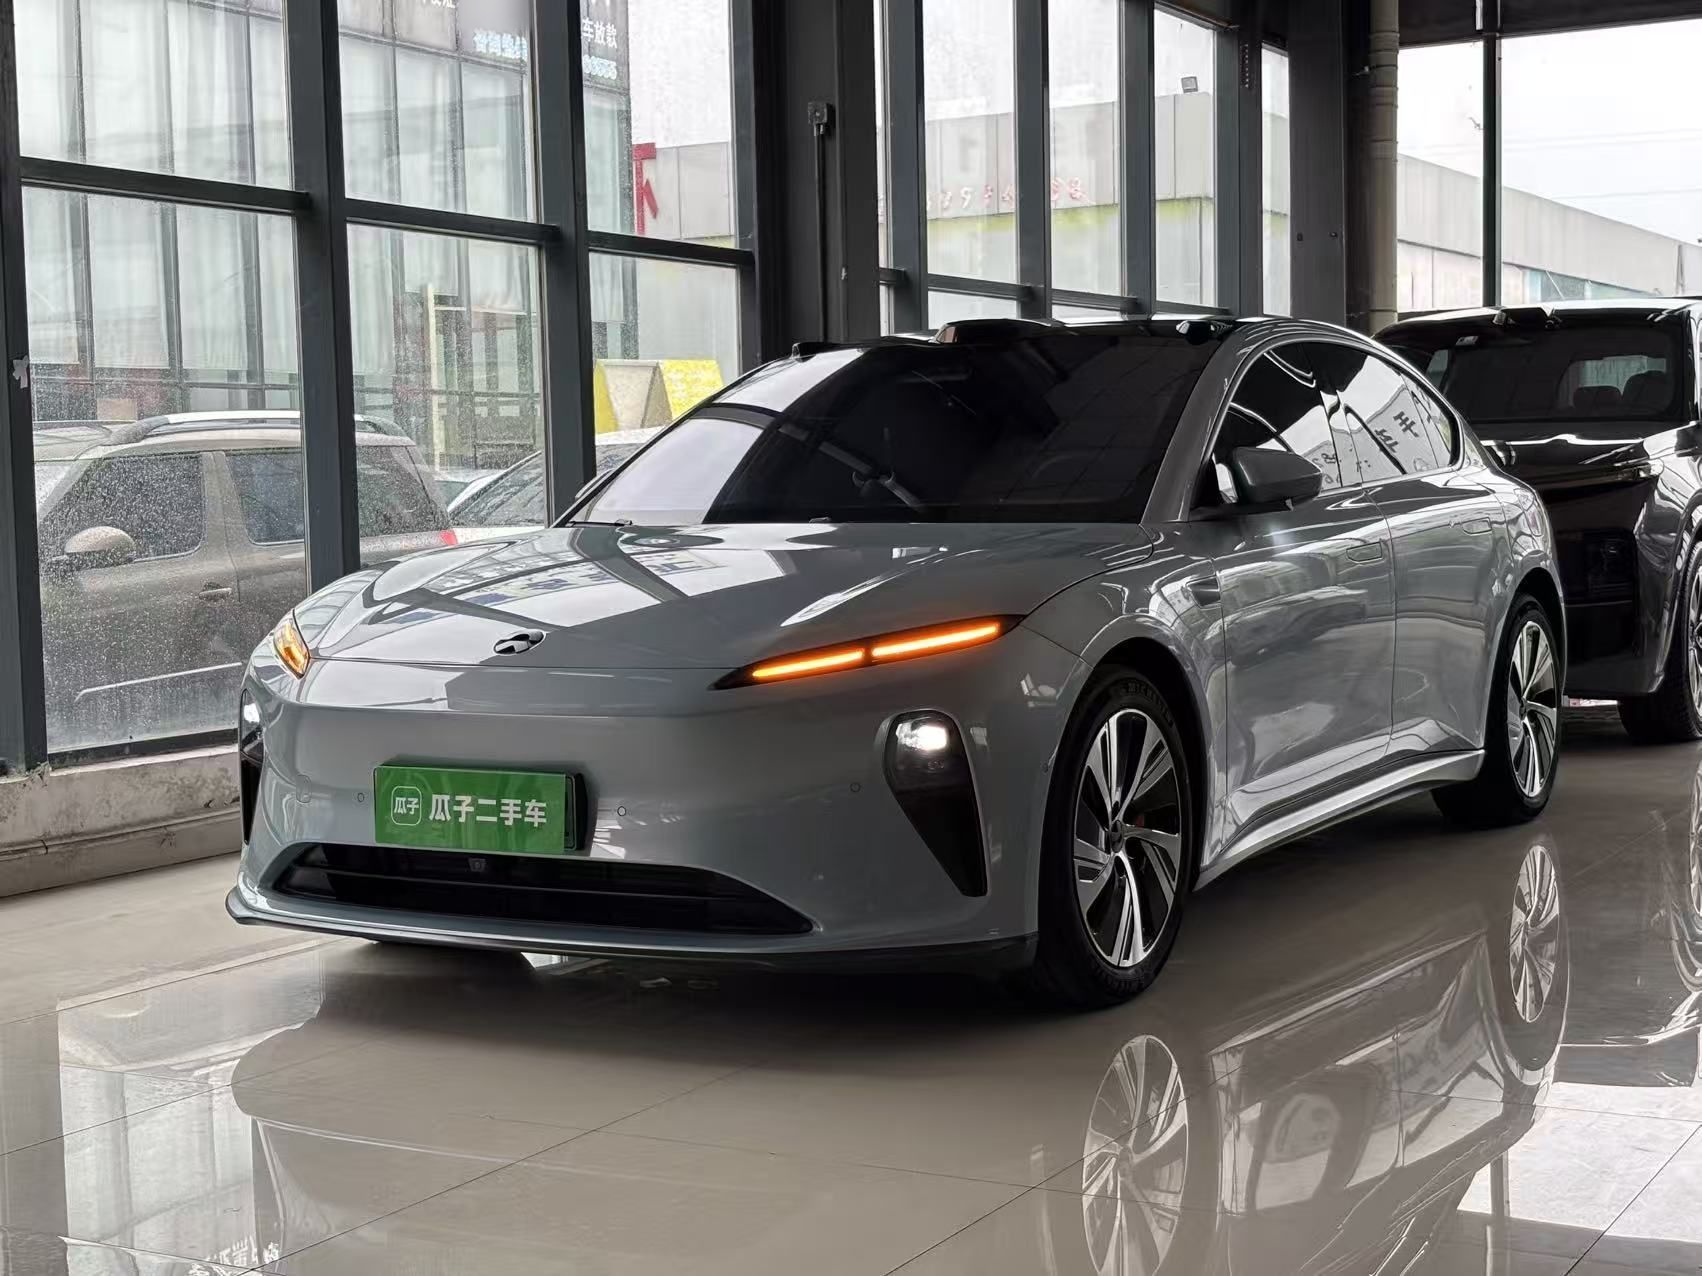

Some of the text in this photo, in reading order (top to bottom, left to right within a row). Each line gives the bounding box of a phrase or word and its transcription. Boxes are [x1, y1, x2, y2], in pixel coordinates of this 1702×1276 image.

[394, 796, 420, 816] 瓜子
[429, 794, 547, 828] 瓜子二手车
